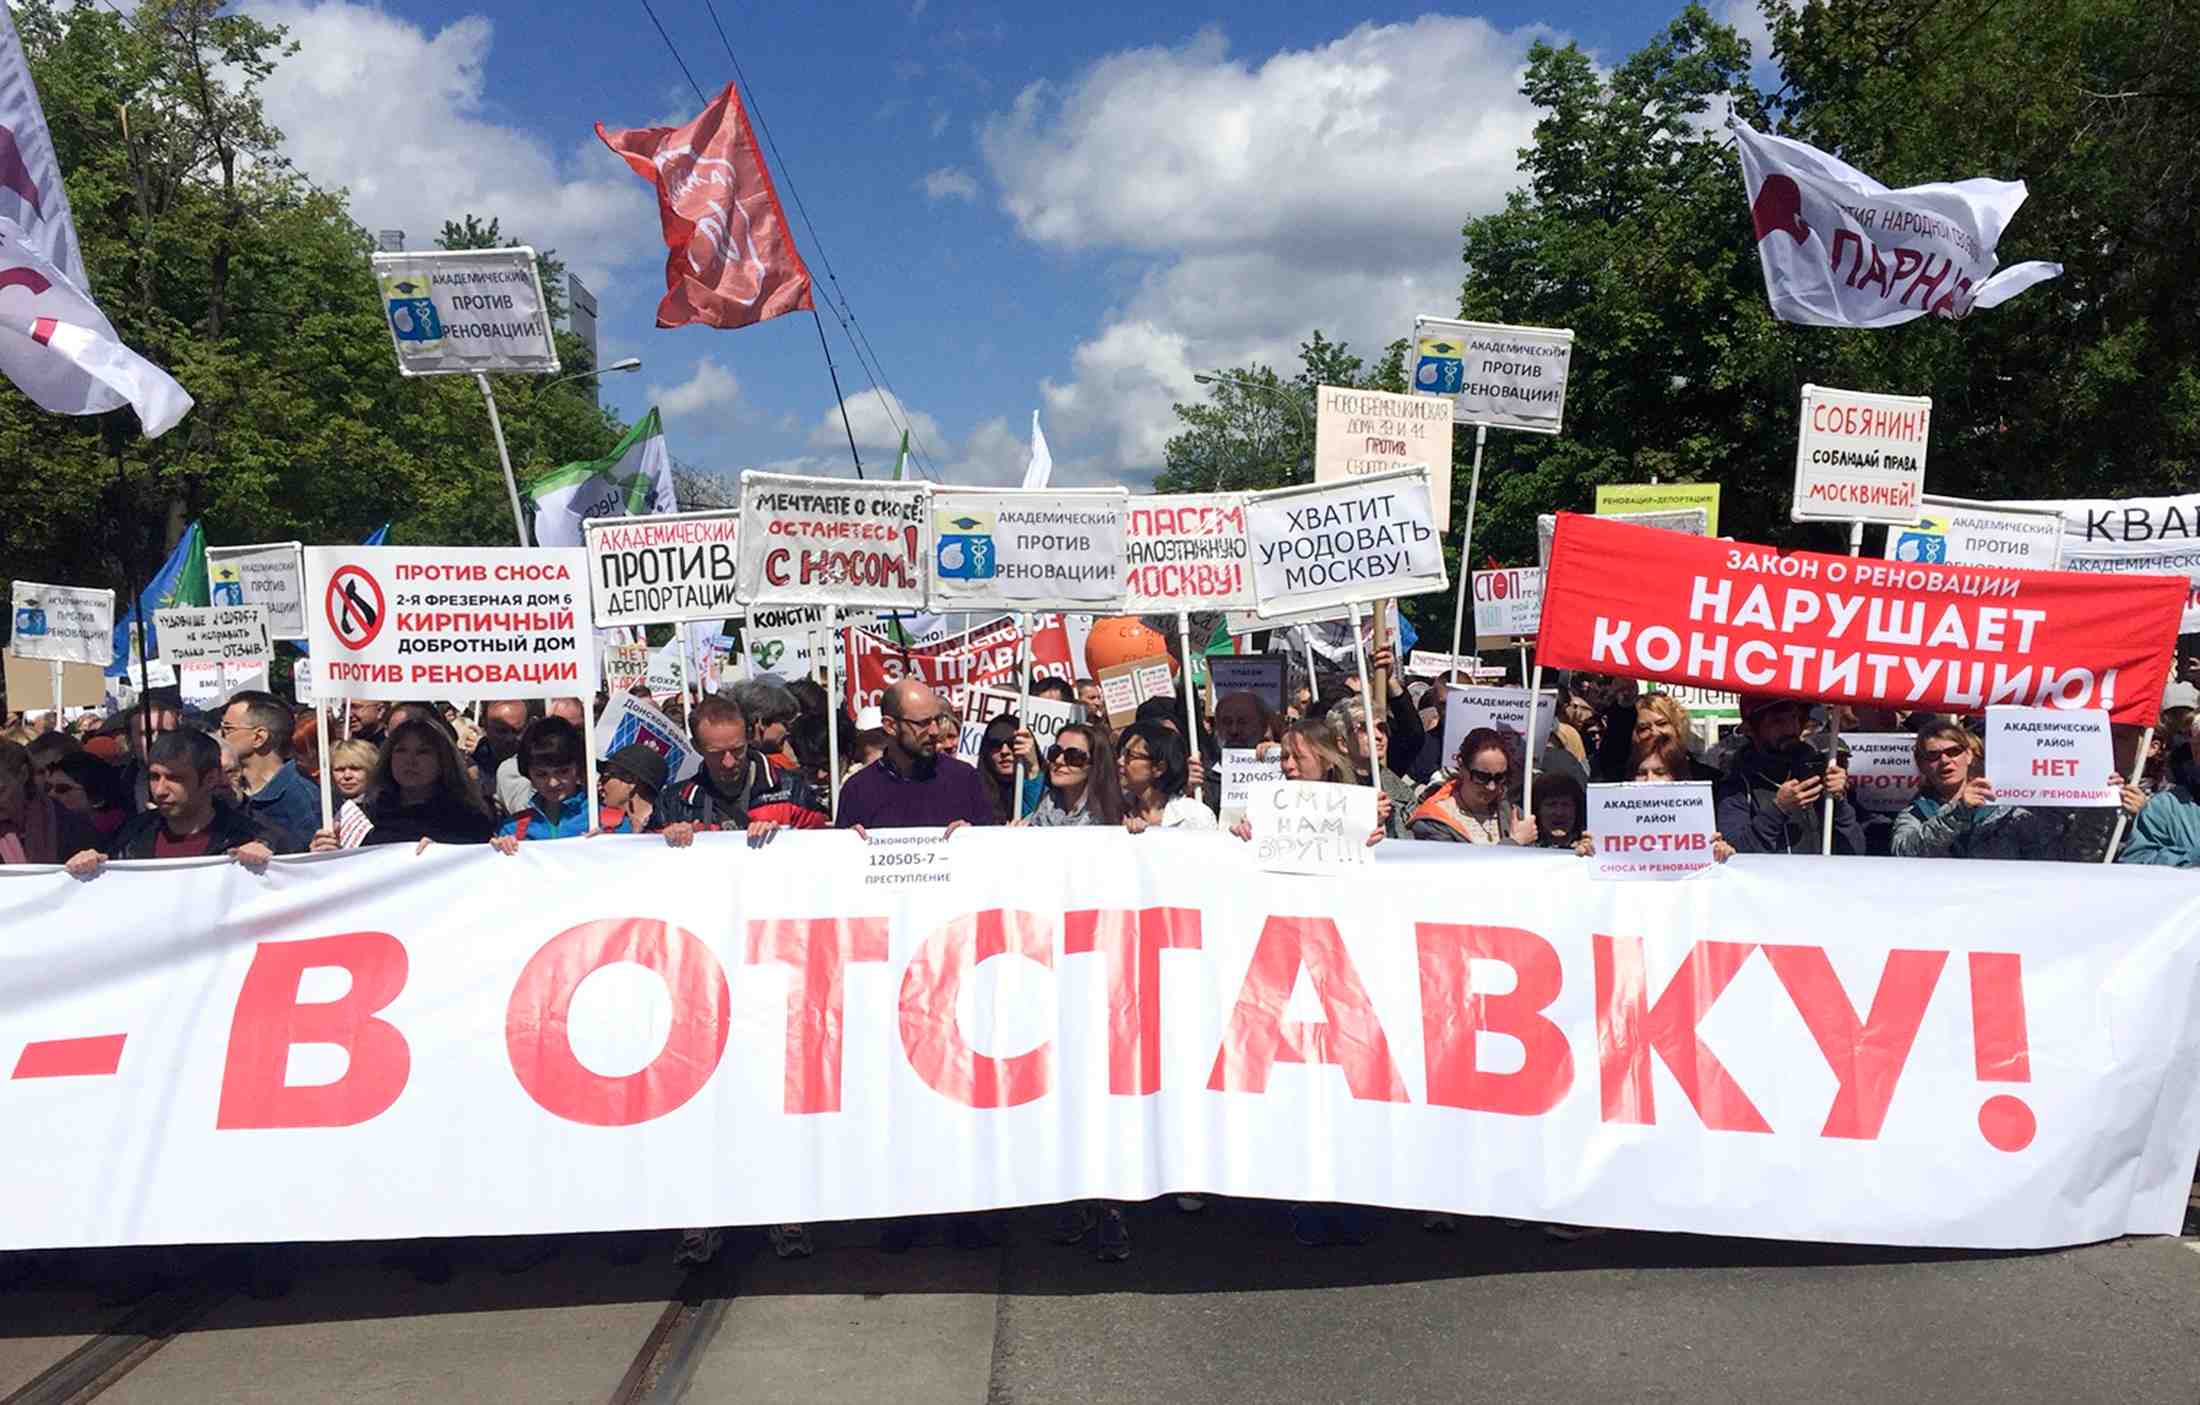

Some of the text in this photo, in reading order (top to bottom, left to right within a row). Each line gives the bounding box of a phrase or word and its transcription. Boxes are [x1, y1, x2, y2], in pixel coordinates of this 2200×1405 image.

[431, 269, 530, 285] АКАДЕМИЧЕСКИЙ
[451, 295, 514, 311] ПРОТИВ
[442, 320, 544, 341] РЕНОВАЦИИ!
[1470, 340, 1567, 359] АКАДЕМИЧЕСКИЙ
[1482, 360, 1542, 378] ПРОТИВ
[1461, 381, 1560, 403] РЕНОВАЦИИ!
[1813, 403, 1925, 442] СОБЯНИН!
[1365, 436, 1407, 456] ПРОТИВ
[1812, 449, 1918, 472] СОБЛЮДАЙ ПРАВА
[756, 493, 851, 516] МЕЧТАЕТЕ
[854, 499, 866, 516] О
[1809, 482, 1916, 508] МОСКВИЧЕЙ!
[999, 510, 1116, 525] АКАДЕМИЧЕСКИЙ
[1286, 494, 1396, 533] ХВАТИТ
[600, 520, 736, 550] АКАДЕМИЧЕСКИЙ
[768, 520, 899, 542] ОСТАНЕТЕСЬ
[1952, 517, 2054, 535] АКАДЕМИЧЕСКИЙ
[1017, 535, 1091, 551] ПРОТИВ
[1258, 519, 1431, 566] УРОДОВАТЬ
[1965, 537, 2030, 556] ПРОТИВ
[600, 544, 737, 588] ПРОТИВ
[766, 525, 919, 589] С НОСОМ!
[395, 564, 571, 581] ПРОТИВ СНОСА
[996, 563, 1116, 583] РЕНОВАЦИИ!
[1285, 550, 1412, 590] МОСКВУ!
[1726, 549, 2023, 598] ЗАКОН О РЕНОВАЦИИ
[251, 580, 287, 593] ПРОТИВ
[1474, 571, 1520, 602] СТОП
[396, 593, 573, 607] 2-Я ФРЕЗЕРНАЯ ДОМ 6
[607, 583, 737, 616] ДЕПОРТАЦИИ
[396, 607, 575, 632] КИРПИЧНЫЙ
[1689, 576, 2047, 654] НАРУШАЕТ
[397, 635, 576, 655] ДОБРОТНЫЙ ДОМ
[328, 662, 404, 682] ПРОТИВ
[411, 662, 578, 684] РЕНОВАЦИИ
[1591, 616, 2120, 711] КОНСТИТУЦИЮ!
[965, 690, 1017, 724] НЕТ
[1462, 697, 1548, 708] АКАДЕМИЧЕСИЙ
[1490, 712, 1524, 721] РАЙОН
[2003, 722, 2102, 733] АКАДЕМИЧЕСКИЙ
[2036, 737, 2075, 748] РАЙОН
[1872, 757, 1911, 766] РАЙОН
[2031, 758, 2080, 777] НЕТ
[1272, 787, 1349, 814] СМИ
[1995, 788, 2036, 799] СНОСУ
[1603, 798, 1704, 810] АКАДЕМИЧЕСКИЙ
[1277, 817, 1346, 836] НАМ
[1635, 814, 1676, 824] РАЙОН
[1604, 833, 1707, 852] ПРОТИВ
[869, 852, 936, 866] 120505-7
[1600, 863, 1637, 872] СНОСА
[1639, 863, 1647, 872] И
[865, 872, 952, 885] ПРЕСТУПЛЕНИЕ
[216, 931, 411, 1130] В
[506, 908, 2037, 1153] ОТСТАВКУ!
